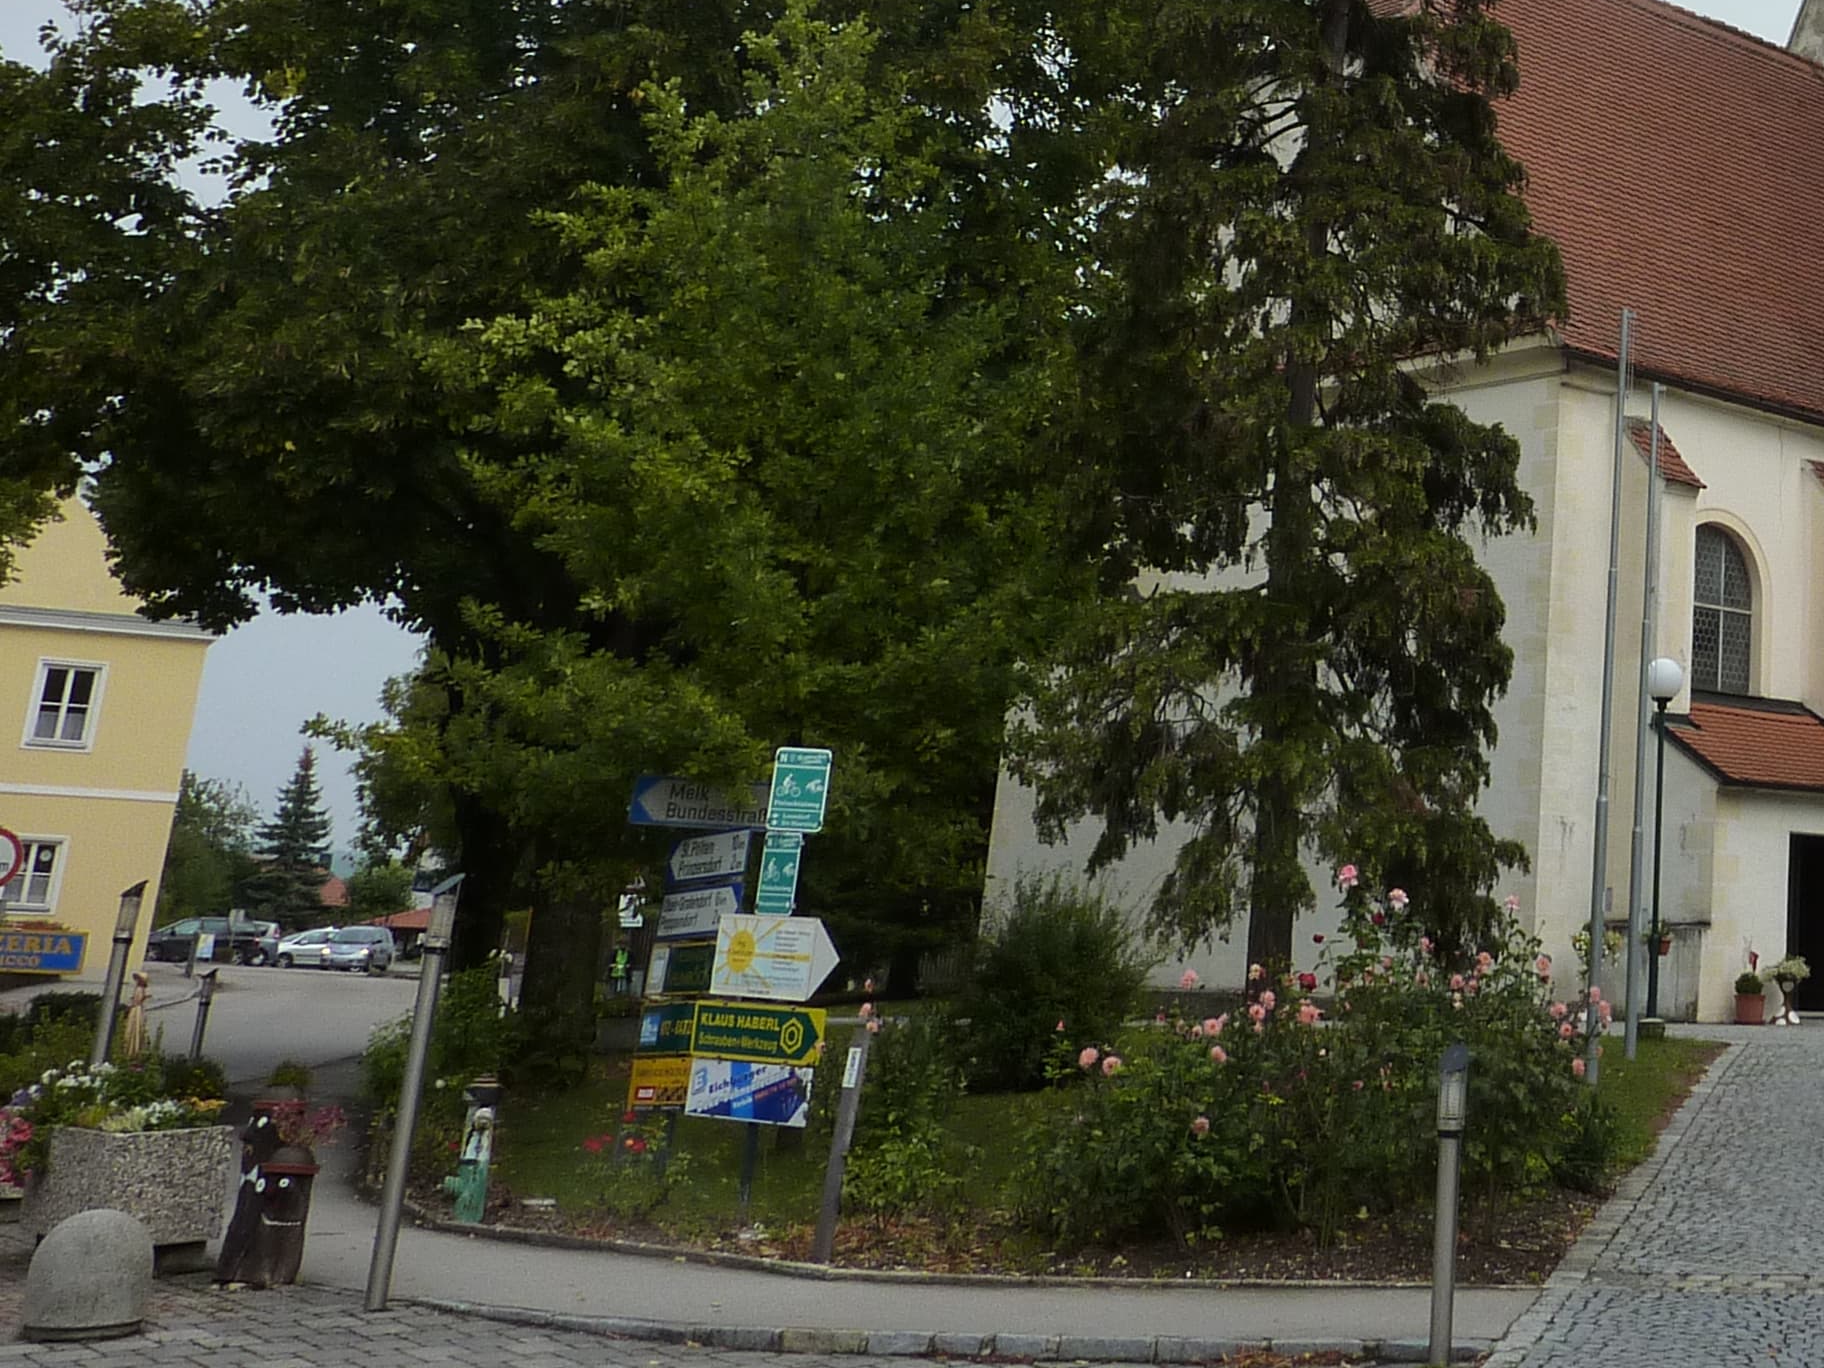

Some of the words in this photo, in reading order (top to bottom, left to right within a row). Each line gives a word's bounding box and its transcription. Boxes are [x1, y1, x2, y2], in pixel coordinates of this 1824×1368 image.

[669, 783, 710, 801] Melk
[700, 1012, 735, 1028] KLAUS
[737, 1014, 780, 1031] HABERL
